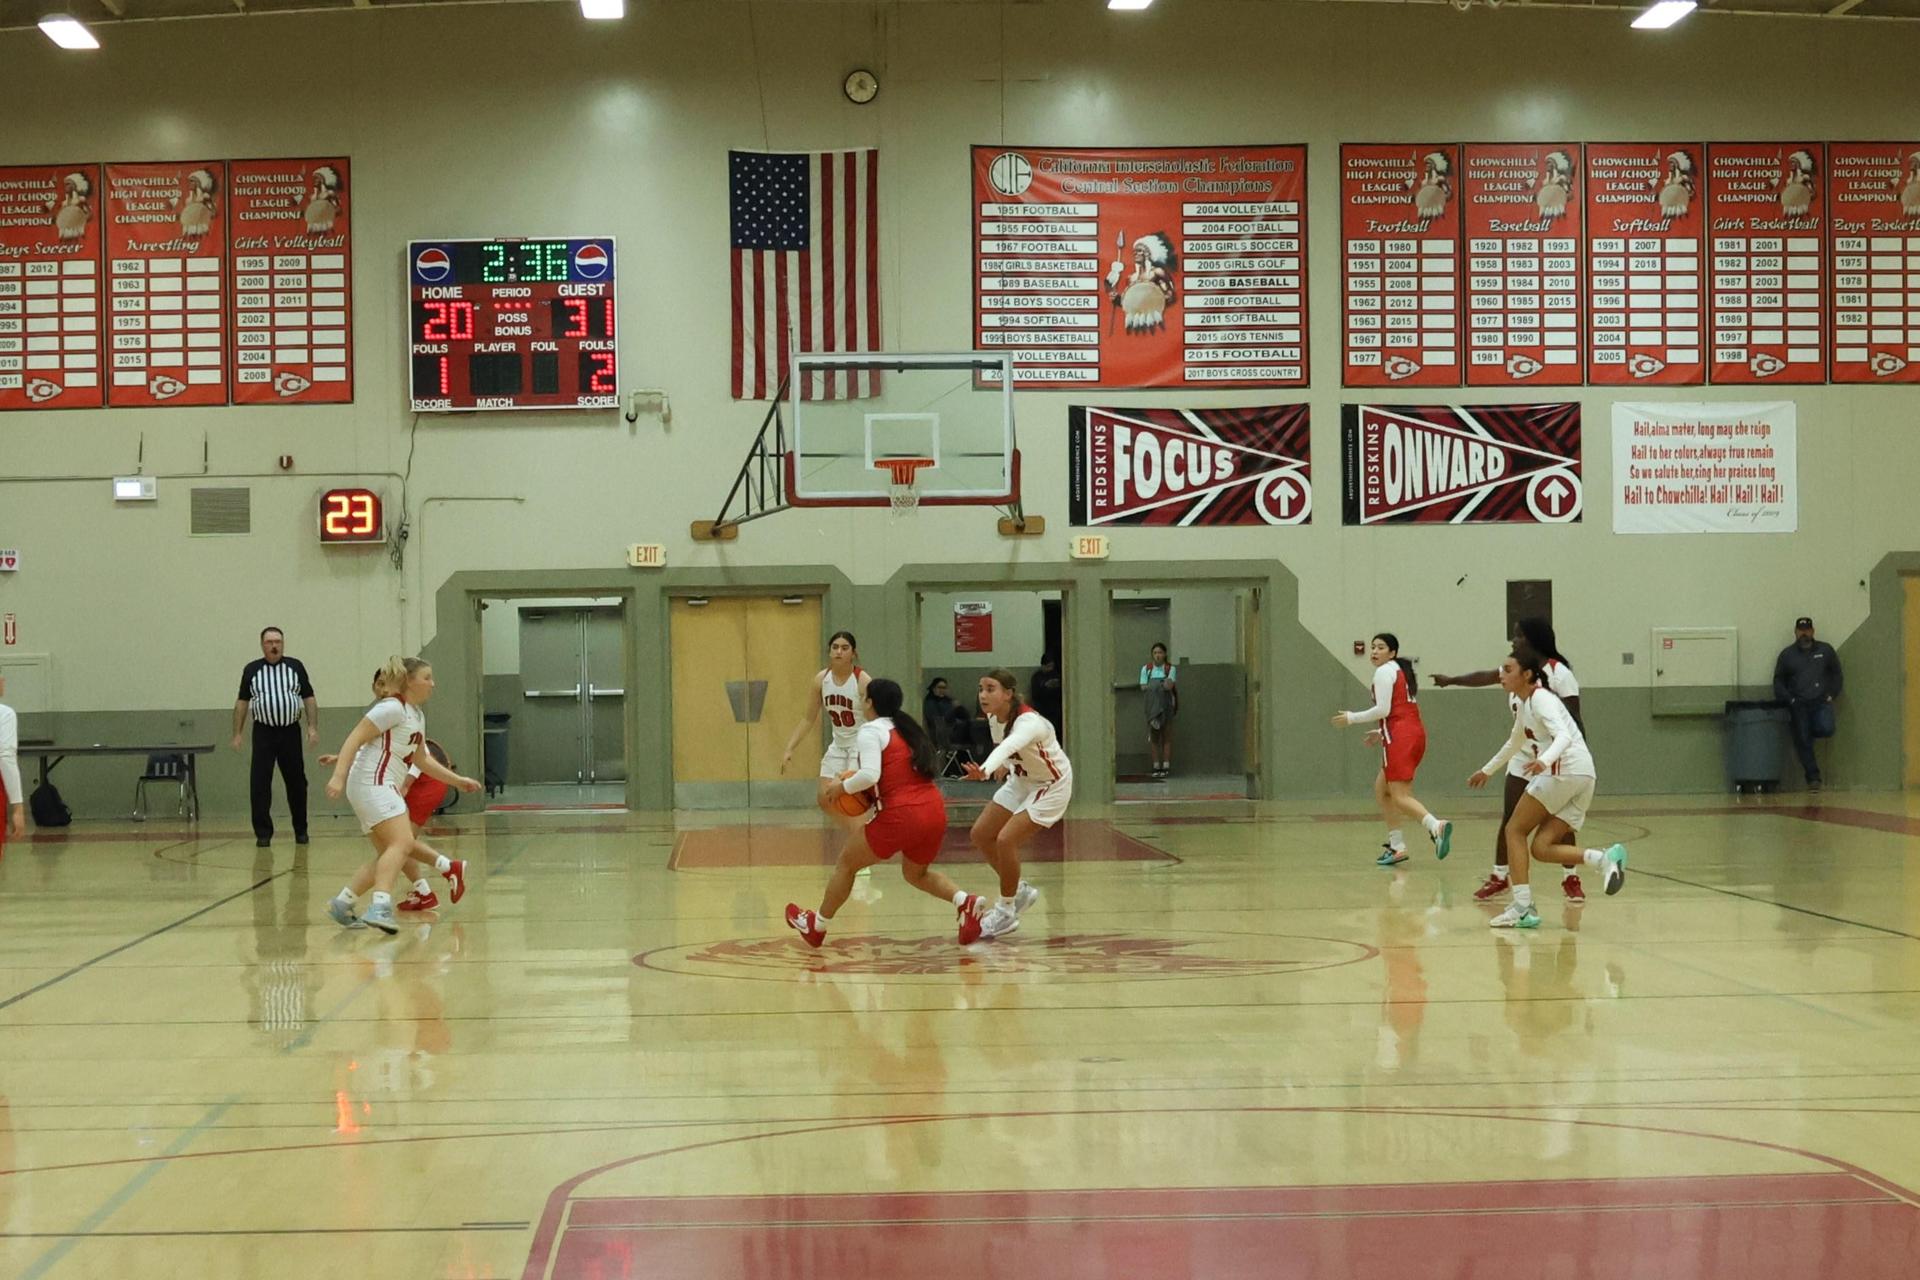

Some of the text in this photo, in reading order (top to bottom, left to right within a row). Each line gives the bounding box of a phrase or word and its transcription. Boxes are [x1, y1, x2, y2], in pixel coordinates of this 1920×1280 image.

[1039, 158, 1293, 173] California Interscholastic Federation
[1348, 158, 1416, 167] CHOWCHILLA
[1346, 170, 1374, 179] HIGH
[1062, 177, 1272, 195] Central Section Champions
[1362, 182, 1401, 192] LEAGUE
[1352, 194, 1414, 204] CHAMPIONS
[1023, 206, 1079, 215] FOOTBALL
[1196, 204, 1290, 214] 2004 VOLLEYBALL
[1202, 223, 1283, 232] 2004 FOOTBALL
[1366, 220, 1430, 233] Football
[1489, 219, 1550, 232] Baseball
[1612, 219, 1672, 233] Softball
[1713, 216, 1818, 231] Girls Basketball
[1834, 219, 1866, 233] Boys
[128, 239, 199, 253] Wrestling
[235, 234, 344, 250] Girls Volleyball
[1189, 242, 1293, 251] 2005 GIRLS SOCCER
[1548, 242, 1570, 250] 1993
[1635, 242, 1656, 250] 2007
[1756, 241, 1778, 250] 2001
[34, 242, 83, 254] Soccer
[483, 243, 567, 282] 2:36
[1035, 262, 1094, 270] BASKETBALL
[1198, 260, 1286, 269] 2005 GIRLS GOLF
[1389, 261, 1411, 269] 2004
[1548, 260, 1571, 269] 2003
[1756, 259, 1778, 268] 2002
[1229, 278, 1290, 287] BASEBALL
[1390, 280, 1411, 288] 2008
[1549, 278, 1570, 287] 2010
[1756, 277, 1778, 286] 2003
[422, 287, 462, 299] HOME
[492, 288, 531, 297] PERIOD
[558, 284, 605, 296] GUEST
[118, 300, 140, 308] 1974
[1046, 298, 1090, 306] SOCCER
[1228, 297, 1281, 305] FOOTBALL
[1390, 298, 1412, 307] 2012
[1548, 297, 1571, 306] 2015
[1756, 296, 1778, 304] 2004
[118, 318, 140, 326] 1975
[424, 302, 472, 339] 20
[498, 314, 528, 322] POSS
[564, 299, 612, 337] 31
[1224, 314, 1278, 322] SOFTBALL
[1390, 317, 1412, 326] 2015
[495, 326, 531, 336] BONUS
[118, 337, 140, 345] 1976
[1034, 334, 1094, 342] BASKETBALL
[1390, 335, 1412, 344] 2016
[413, 344, 448, 354] FOULS
[474, 343, 515, 352] PLAYER
[531, 342, 558, 351] FOUL
[579, 341, 614, 350] FOULS
[1018, 352, 1087, 360] VOLLEYBALL
[1223, 350, 1297, 358] FOOTBALL
[440, 357, 448, 394] 1
[592, 354, 613, 391] 2
[1018, 370, 1087, 379] VOLLEYBALL
[477, 398, 513, 408] MATCH
[1698, 422, 1714, 439] long
[1716, 424, 1733, 439] may
[1632, 446, 1646, 460] Hail
[1650, 447, 1657, 459] to
[1659, 445, 1671, 460] her
[1729, 446, 1745, 459] true
[1747, 445, 1774, 459] remain
[1095, 425, 1107, 507] REDSKINS
[1113, 424, 1234, 506] FOCUS
[1368, 423, 1379, 505] REDSKINS
[1384, 423, 1505, 505] ONWARD
[1630, 465, 1640, 479] So
[1642, 469, 1652, 479] we
[1714, 464, 1726, 478] her
[1759, 464, 1775, 481] long
[1624, 484, 1778, 504] Hail to Chowchilla! Hail Hail Hail
[326, 495, 372, 534] 23
[1080, 538, 1100, 554] EXIT
[637, 546, 658, 562] EXIT
